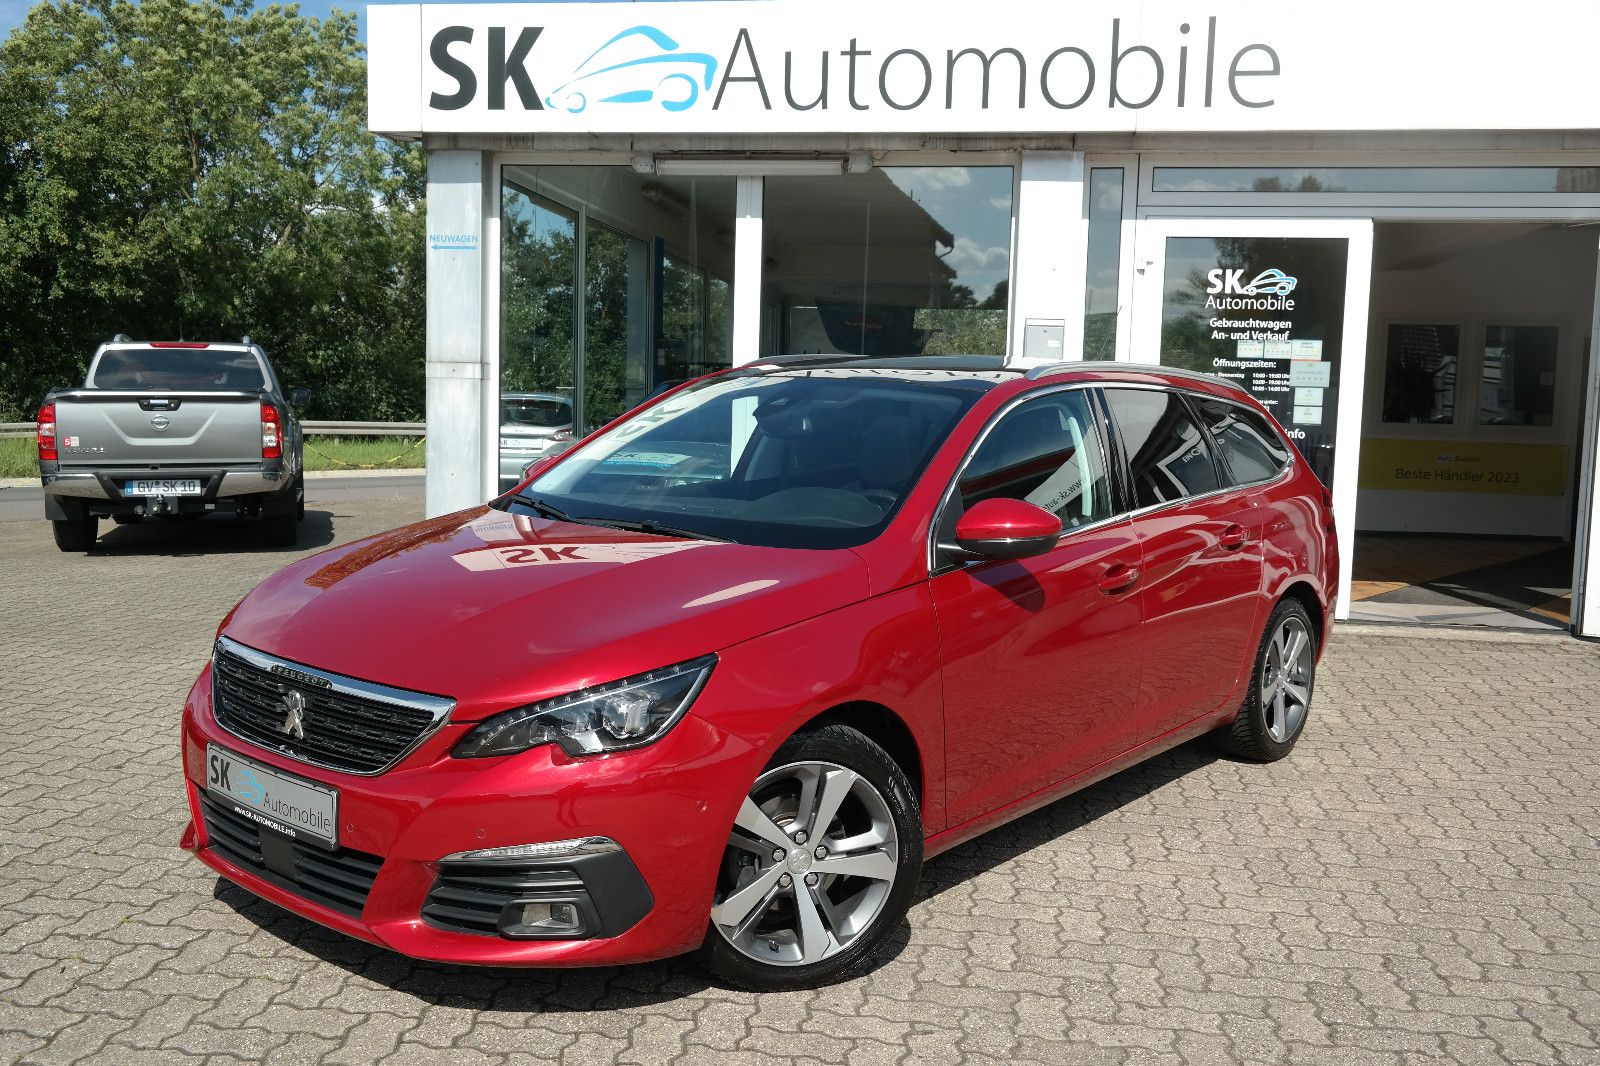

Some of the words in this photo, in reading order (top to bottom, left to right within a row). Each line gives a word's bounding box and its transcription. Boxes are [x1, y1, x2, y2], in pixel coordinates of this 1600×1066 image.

[429, 25, 545, 111] SK
[711, 16, 1281, 111] Automobile
[430, 234, 478, 243] NEUWAGEN
[1206, 268, 1245, 294] SK
[1204, 294, 1295, 311] Automobile
[1209, 317, 1292, 331] Gebrauchtwagen
[1211, 329, 1229, 340] An-
[1230, 330, 1250, 340] und
[1251, 330, 1290, 341] Verkauf
[1212, 357, 1277, 369] Öffnungszeiten:
[1394, 468, 1432, 480] Beste
[1434, 469, 1484, 482] Händler
[1487, 472, 1520, 484] 2023
[137, 481, 153, 493] GV
[162, 481, 178, 493] SK
[180, 481, 196, 493] 10
[210, 754, 232, 792] SK
[263, 791, 331, 832] Automobile
